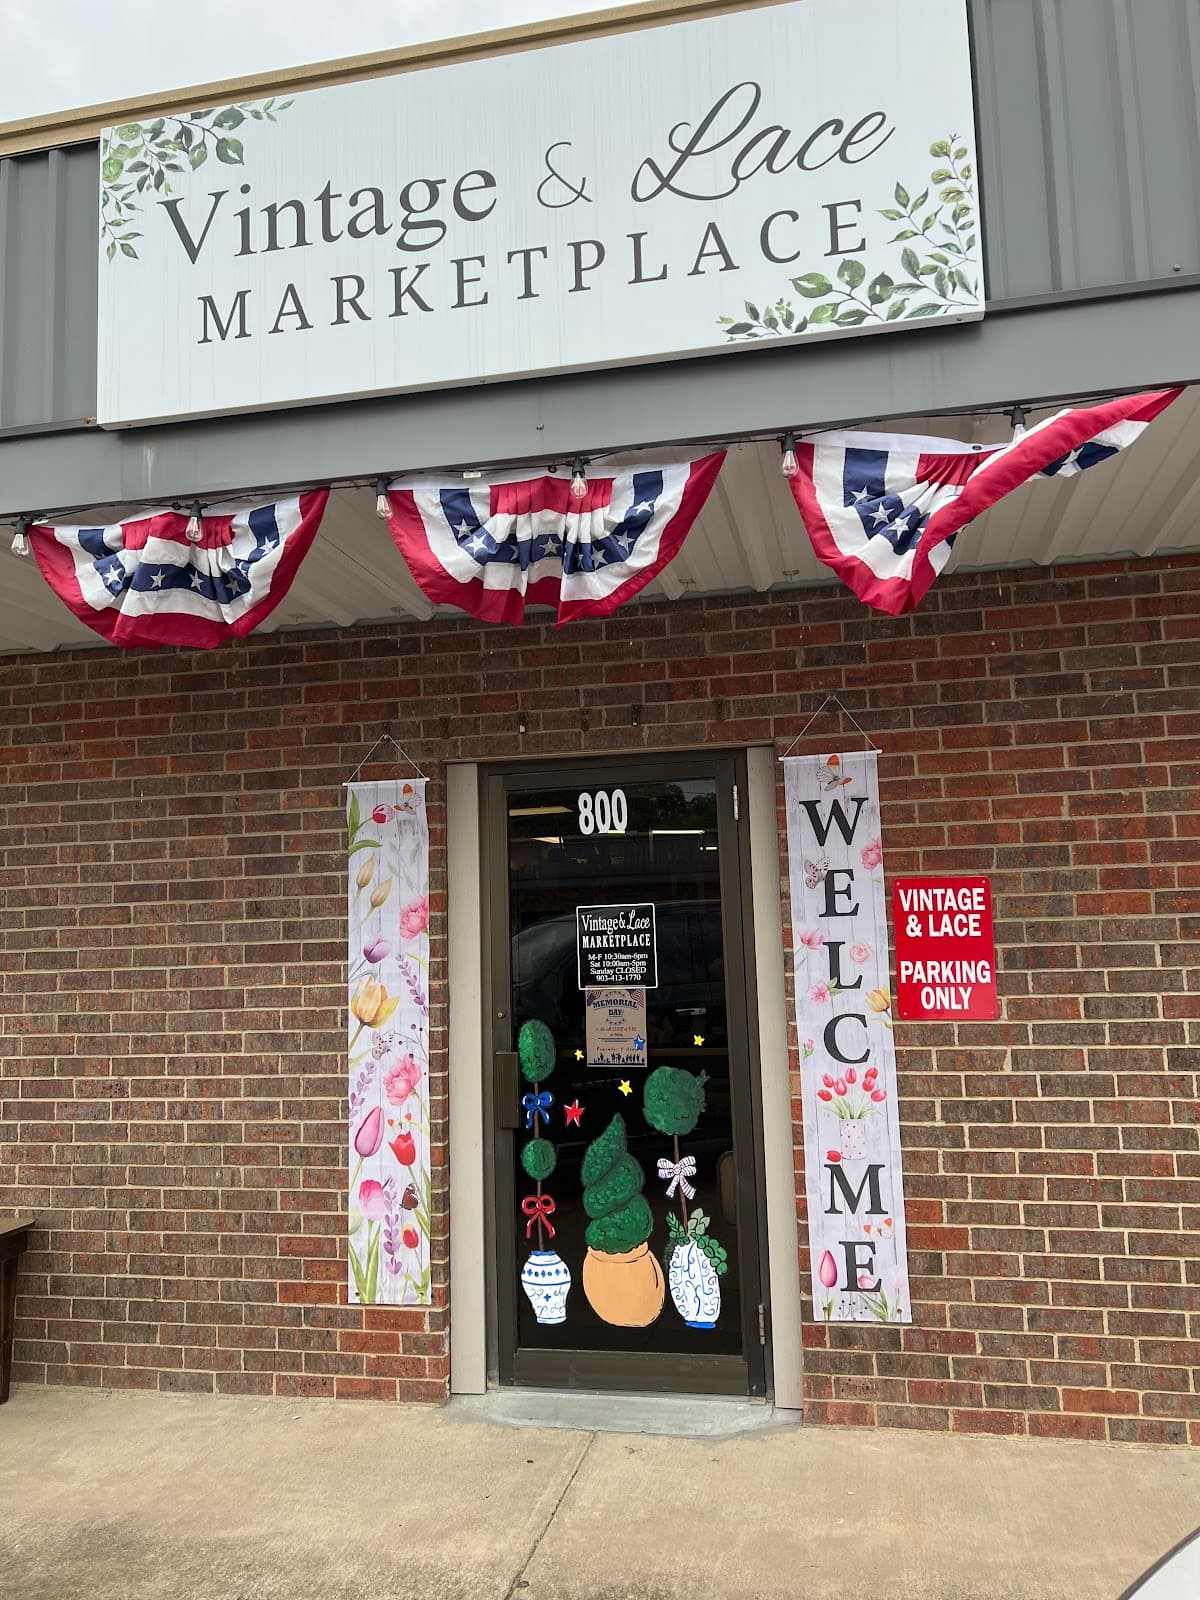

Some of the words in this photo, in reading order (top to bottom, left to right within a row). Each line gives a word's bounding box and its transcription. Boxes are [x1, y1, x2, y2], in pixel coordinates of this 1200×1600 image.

[157, 169, 497, 265] Vintage
[538, 141, 592, 208] &
[633, 81, 896, 201] Lace
[198, 200, 868, 345] MARKETPLACE
[578, 788, 628, 835] 800
[899, 887, 986, 911] VINTAGE
[581, 915, 618, 935] Vintage
[619, 912, 626, 929] &
[627, 909, 651, 930] Lace
[905, 914, 923, 937] &
[928, 914, 982, 937] LACE
[582, 934, 651, 949] MARKETPLACE
[590, 968, 614, 976] Sunday
[596, 974, 641, 982] 903-413-1770
[900, 960, 991, 983] PARKING
[592, 998, 638, 1009] MEMORIAL
[921, 986, 972, 1010] ONLY
